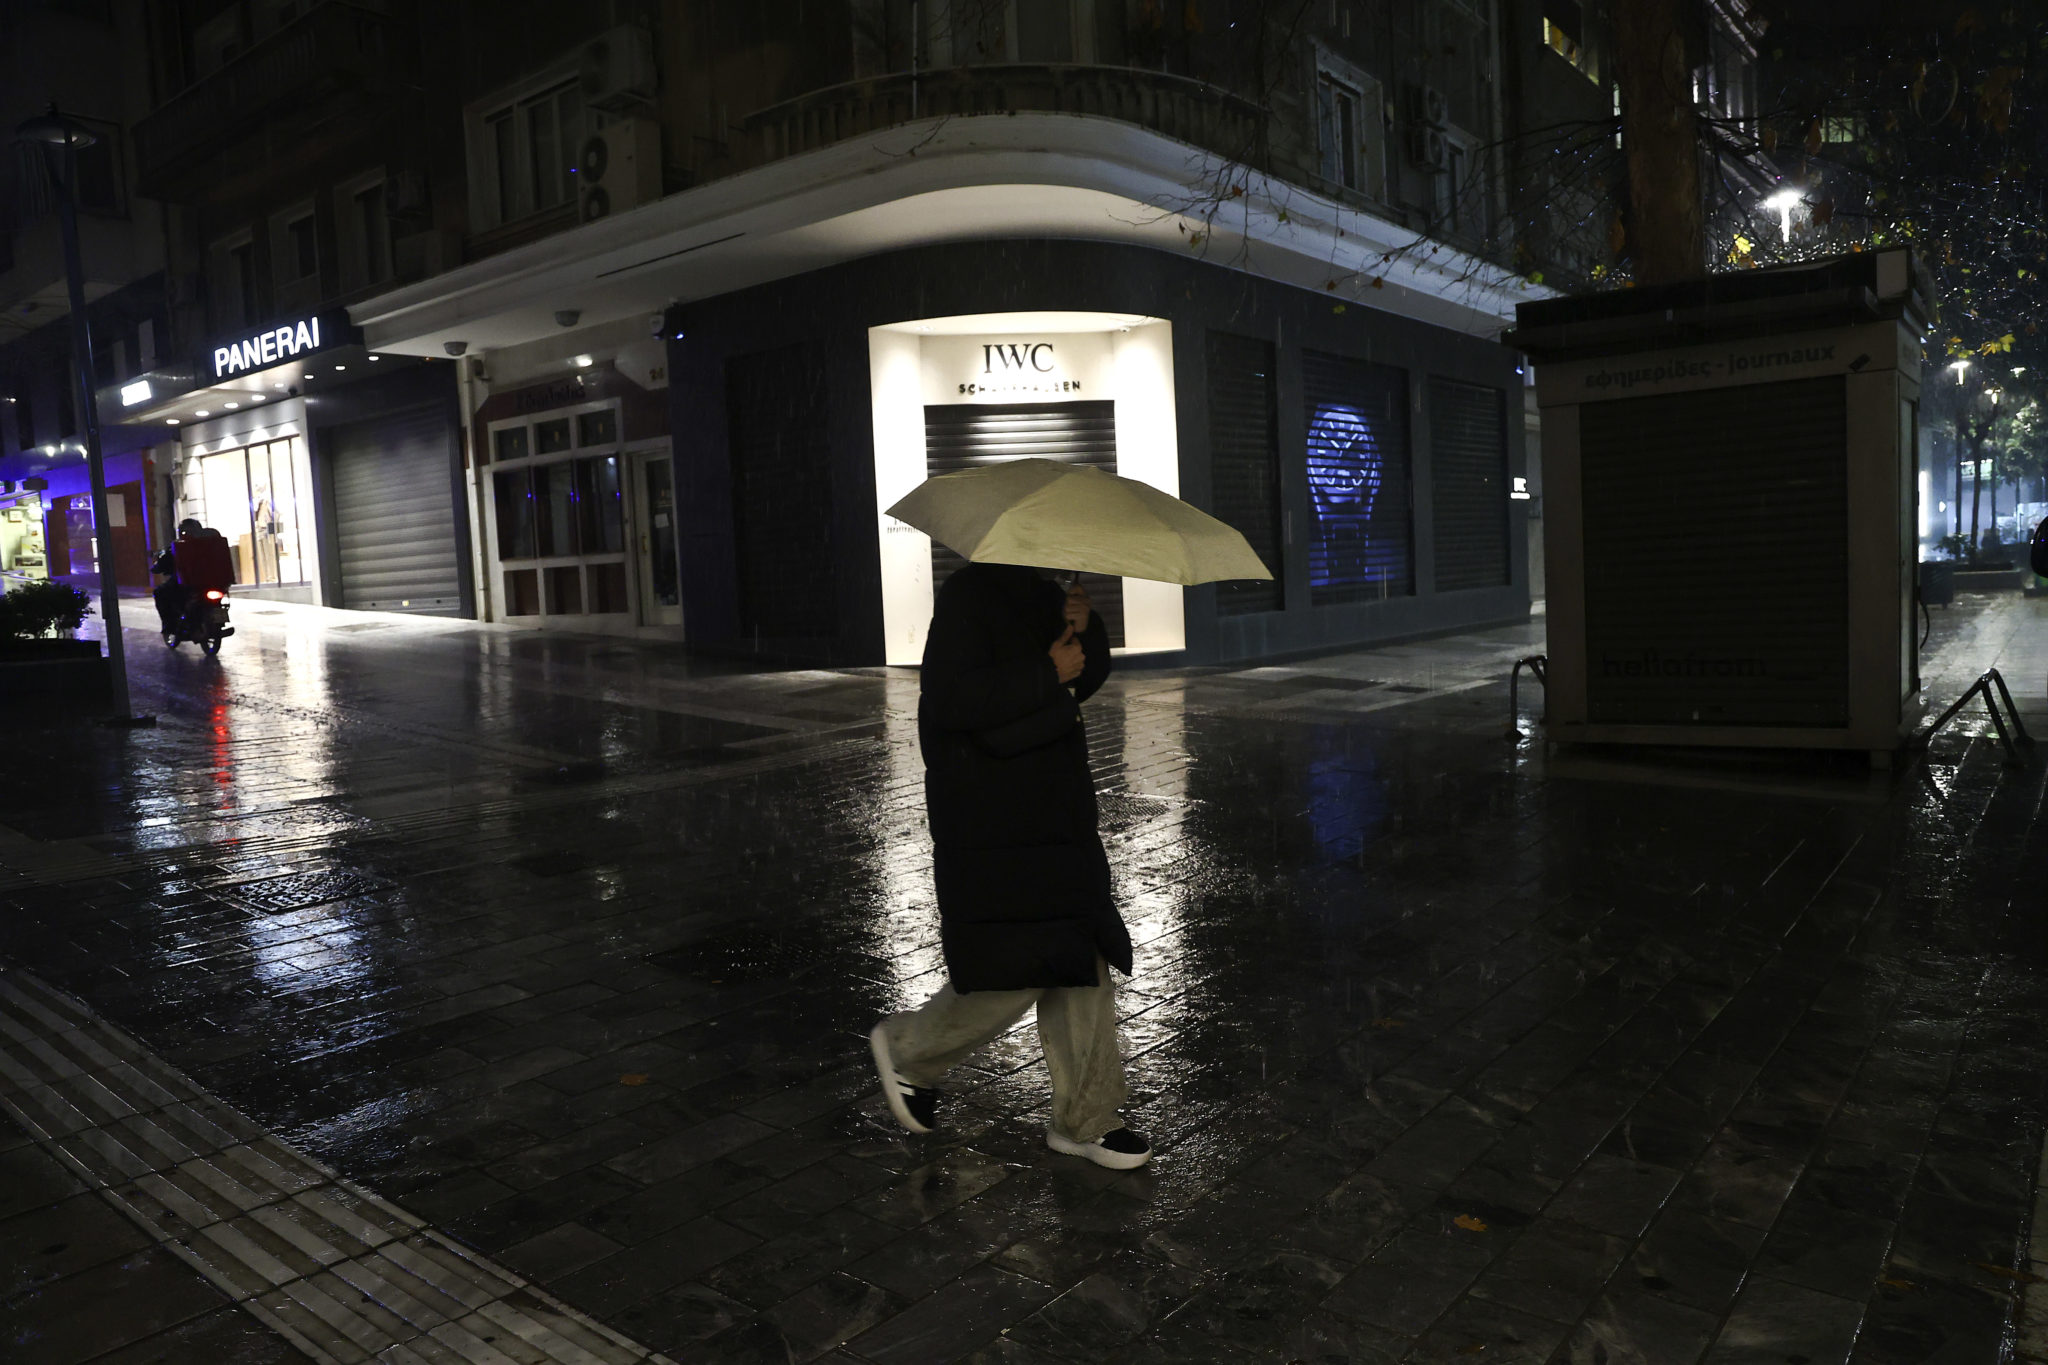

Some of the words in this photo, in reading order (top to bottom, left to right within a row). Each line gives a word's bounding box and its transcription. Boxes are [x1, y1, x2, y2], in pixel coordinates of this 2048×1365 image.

[214, 316, 320, 378] PANERAI
[982, 342, 1055, 374] IWC
[1728, 343, 1836, 375] journaux
